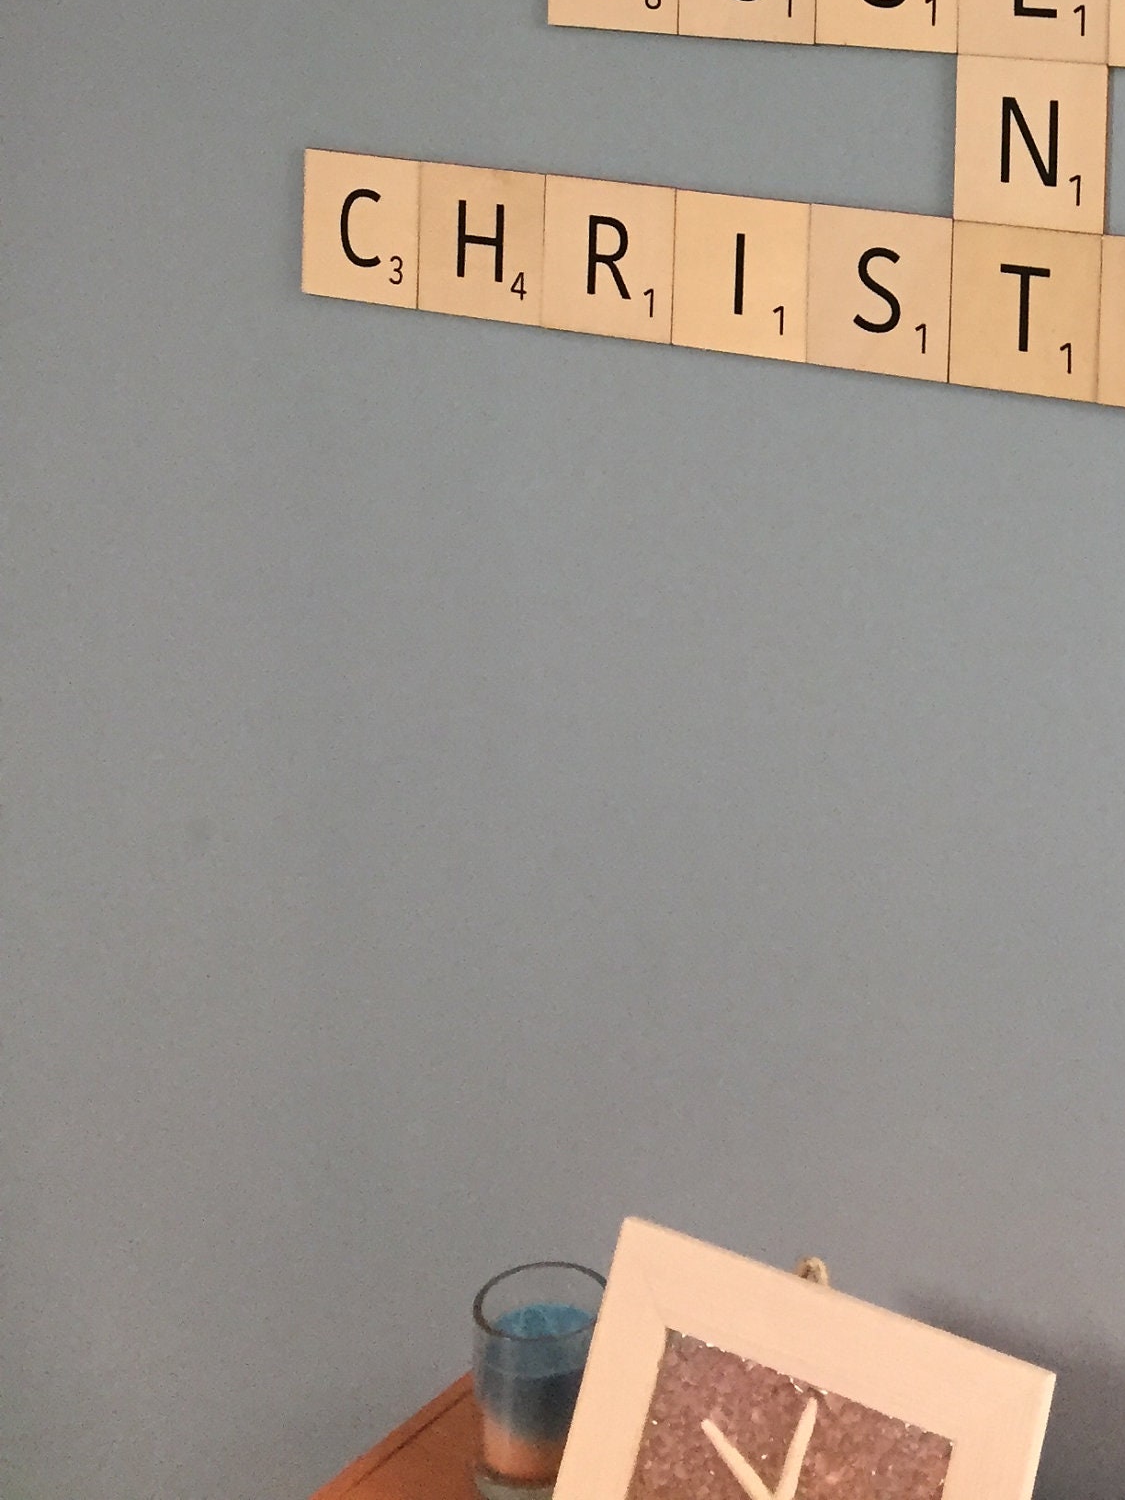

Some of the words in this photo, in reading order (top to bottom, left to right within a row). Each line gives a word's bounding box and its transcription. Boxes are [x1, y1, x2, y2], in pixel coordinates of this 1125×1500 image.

[1072, 3, 1087, 38] 1
[1067, 173, 1083, 208] 1
[387, 254, 405, 286] 3
[509, 270, 529, 302] 4
[642, 287, 656, 319] 1
[771, 304, 786, 337] 1
[913, 322, 928, 356] 1
[1058, 341, 1073, 376] 1
